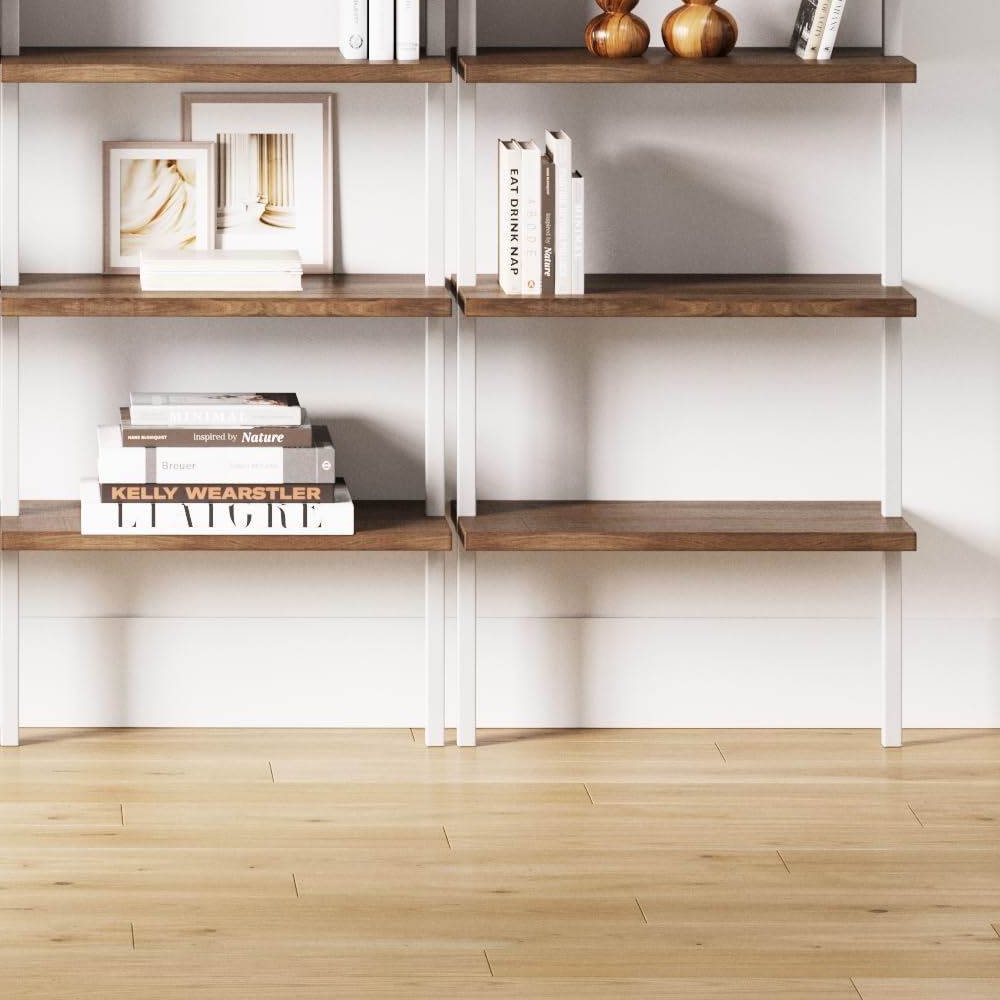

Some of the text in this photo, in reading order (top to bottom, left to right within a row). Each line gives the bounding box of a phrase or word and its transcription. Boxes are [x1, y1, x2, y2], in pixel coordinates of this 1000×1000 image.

[510, 168, 519, 276] EAT DRINK NAP
[544, 246, 553, 277] Nature
[193, 432, 225, 443] Inspired
[227, 432, 238, 443] by
[241, 431, 284, 443] Nature
[161, 461, 196, 470] Breuer
[111, 486, 322, 500] KELLY WEARSTLER
